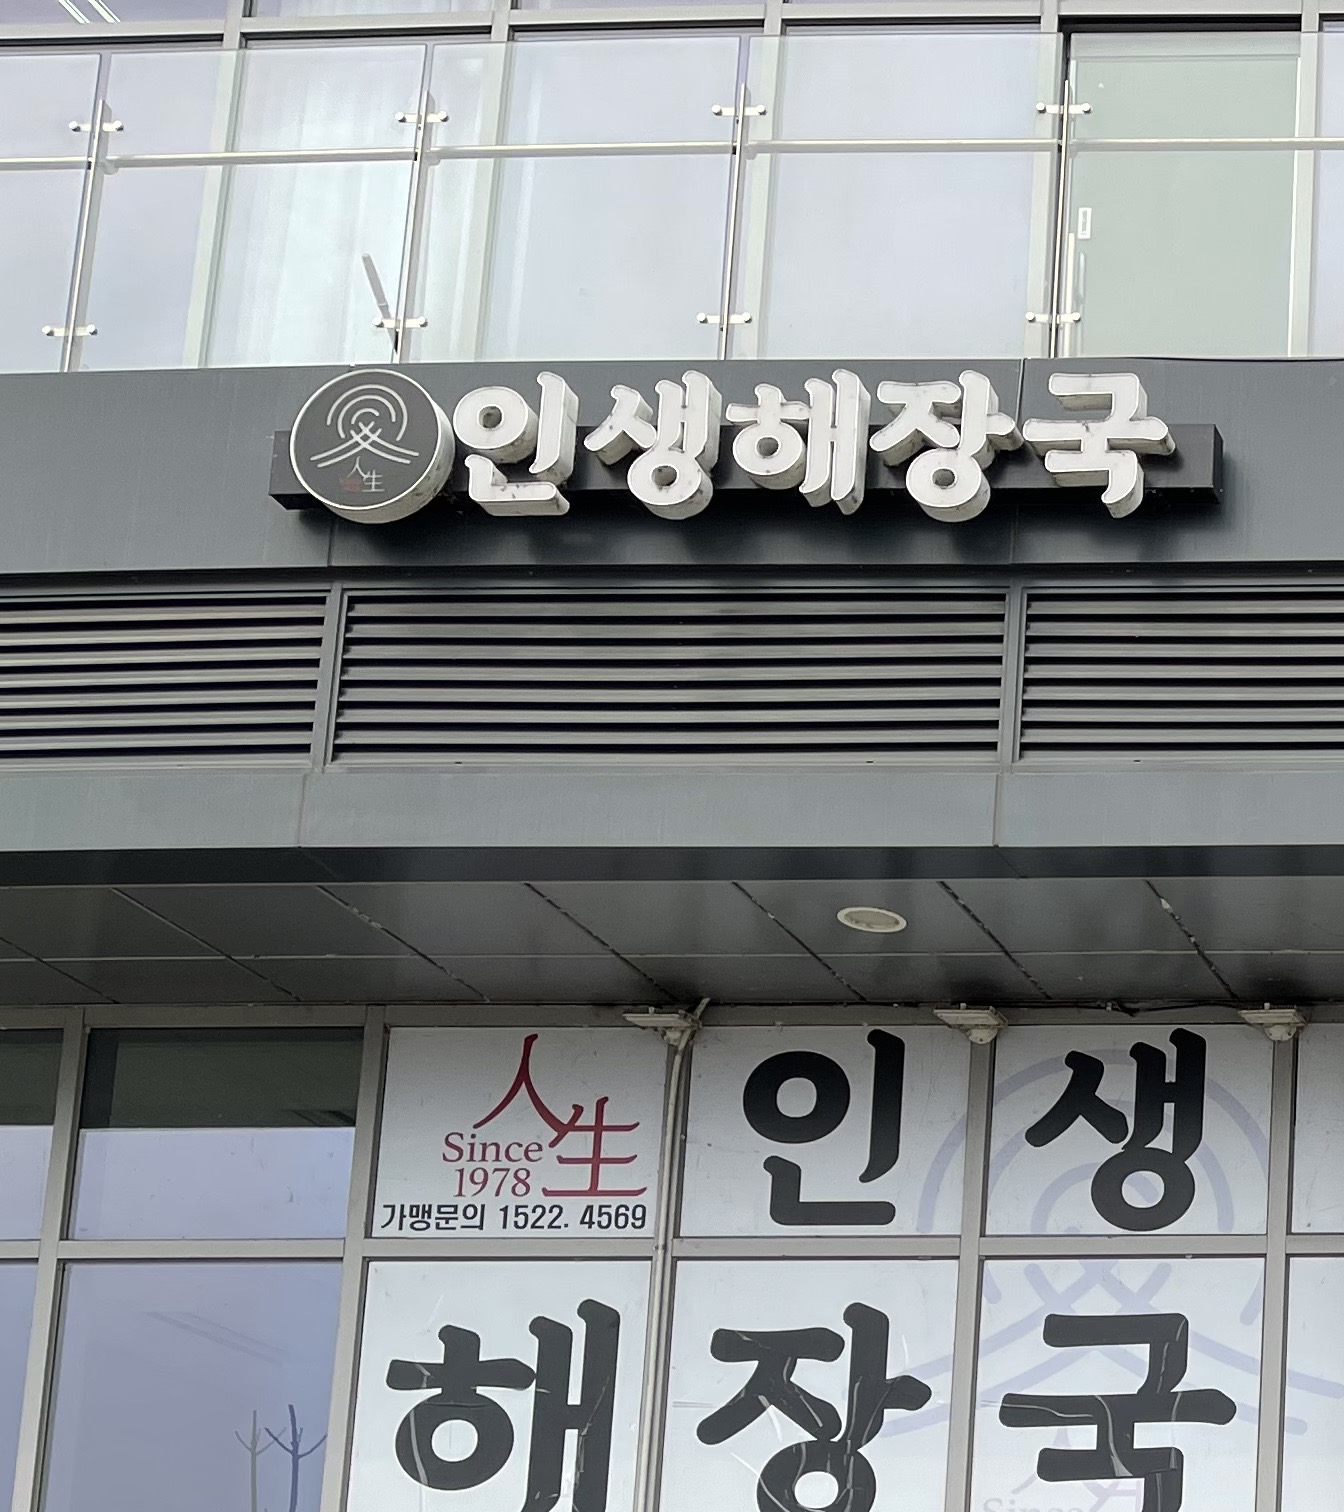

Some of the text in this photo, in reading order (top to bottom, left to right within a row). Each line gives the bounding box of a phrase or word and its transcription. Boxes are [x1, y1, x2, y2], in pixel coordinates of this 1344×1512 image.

[453, 366, 1176, 521] 인생해장국
[442, 1130, 544, 1163] Since
[472, 1033, 647, 1198] 人生
[743, 1028, 1207, 1232] 인생
[380, 1203, 647, 1232] 가맹문의 1522. 4569
[455, 1166, 531, 1198] 1978
